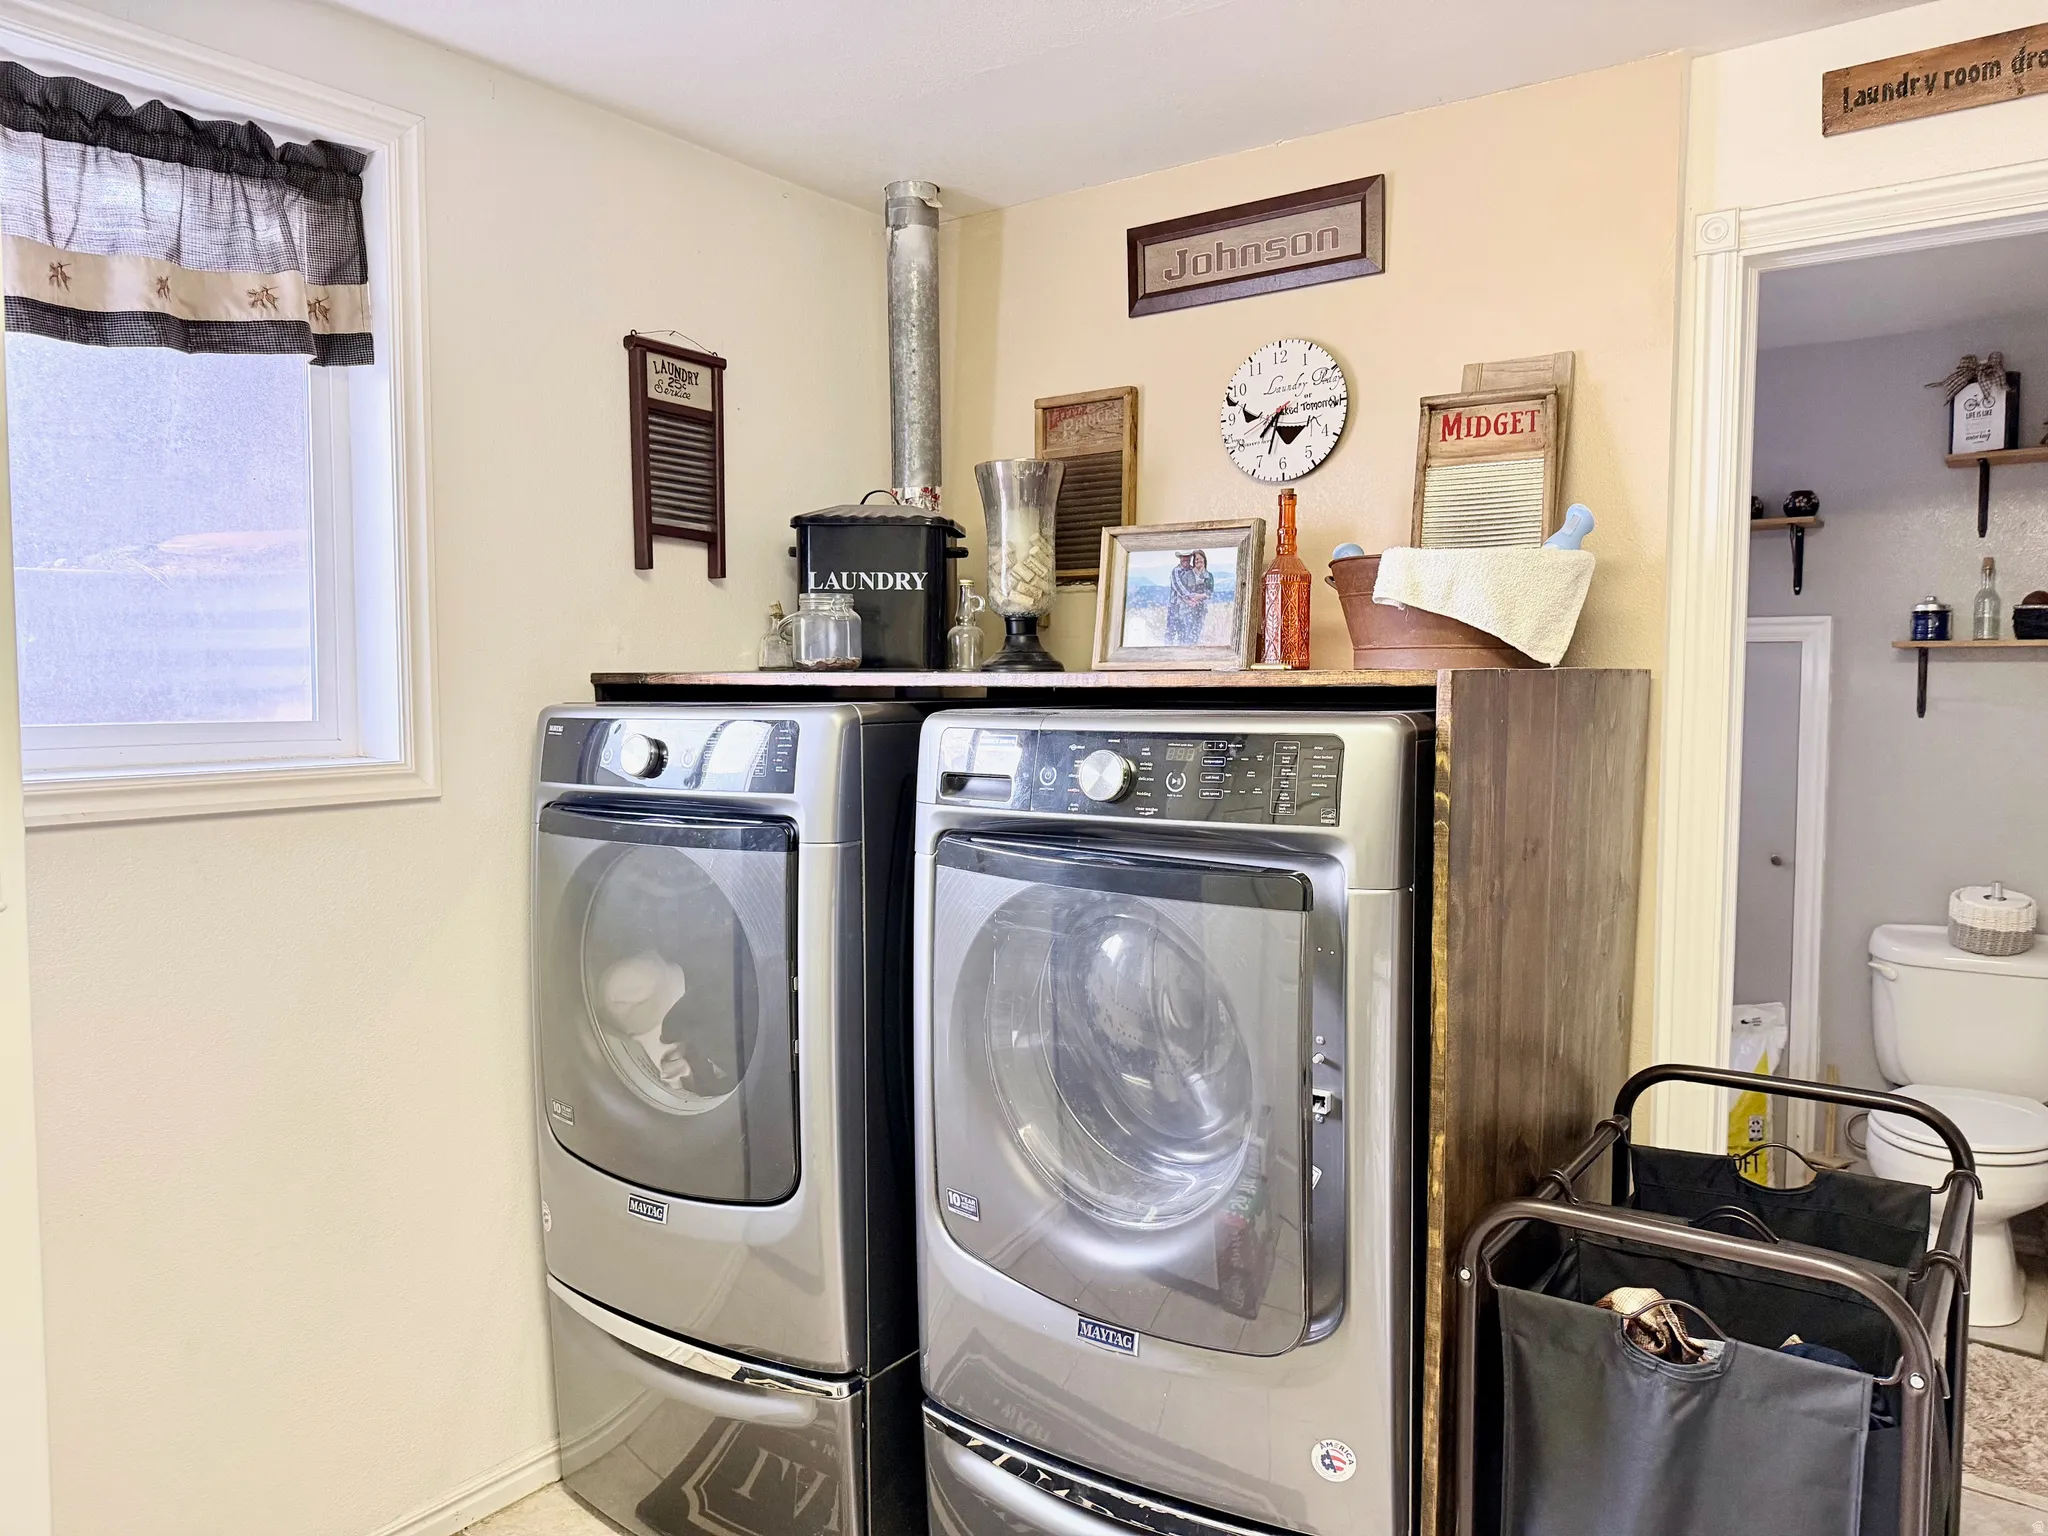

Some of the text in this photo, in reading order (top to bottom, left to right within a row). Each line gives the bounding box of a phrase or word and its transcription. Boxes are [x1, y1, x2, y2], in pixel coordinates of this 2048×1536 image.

[1842, 70, 1938, 113] Laundry
[1944, 57, 2002, 90] room
[1162, 226, 1340, 283] Johnson
[1272, 350, 1288, 365] 12
[1302, 352, 1309, 366] 1
[653, 359, 699, 386] LAUNDRY
[1249, 362, 1262, 377] 11
[1233, 382, 1247, 397] 10
[1228, 413, 1236, 427] 9
[1439, 409, 1541, 442] MIDGET
[1321, 424, 1329, 437] 4
[1305, 445, 1314, 459] 5
[1256, 455, 1264, 468] 7
[1278, 457, 1287, 470] 6
[808, 571, 929, 591] LAUNDRY
[1728, 1152, 1760, 1174] OFT
[948, 1190, 961, 1207] 10
[630, 1199, 663, 1219] MAYTAG
[1079, 1321, 1133, 1349] MAYTAG
[1319, 1441, 1355, 1466] AMERICA
